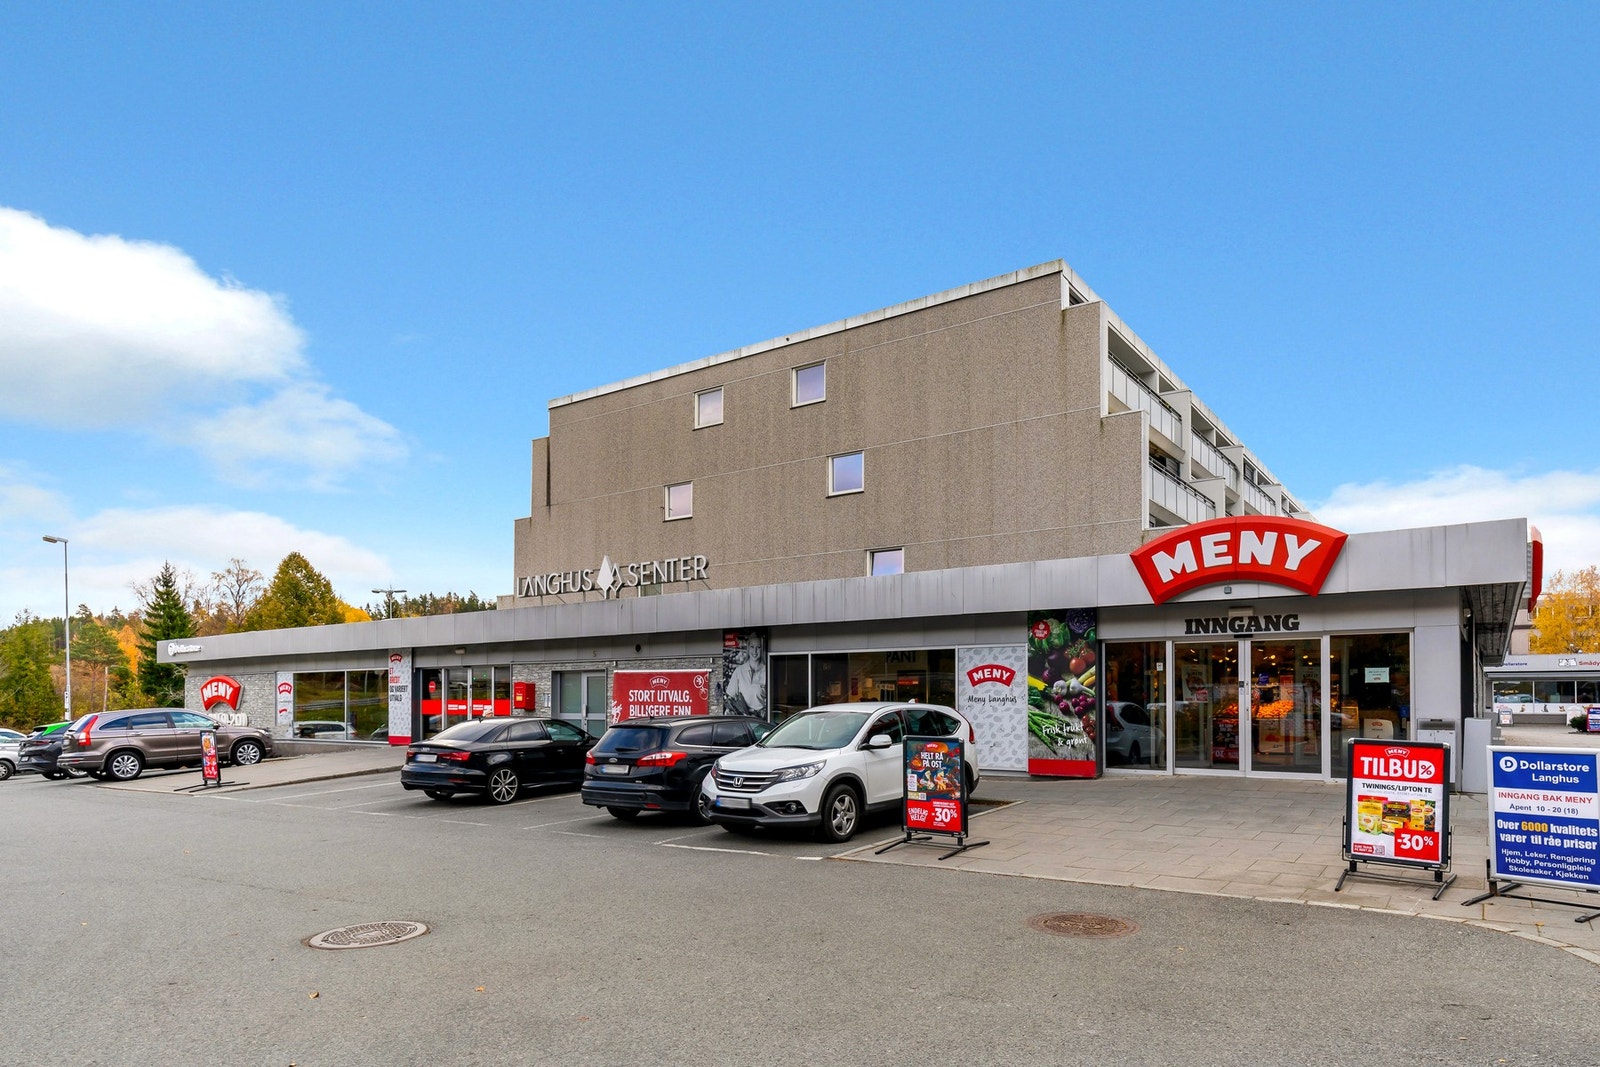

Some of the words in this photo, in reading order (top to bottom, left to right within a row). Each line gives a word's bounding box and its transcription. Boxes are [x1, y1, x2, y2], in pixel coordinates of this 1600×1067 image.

[1151, 530, 1322, 583] MENY
[516, 569, 593, 598] LANGHUS
[627, 555, 709, 587] SENTER
[1185, 614, 1300, 634] INNGANG
[972, 668, 1011, 681] MENY
[202, 681, 233, 701] MENY
[629, 689, 655, 702] STORT
[657, 689, 692, 703] UTVALG.
[968, 695, 986, 706] Meny
[989, 694, 1017, 706] Langhus
[629, 705, 670, 717] BILLIGERE
[673, 705, 691, 715] ENN
[1042, 724, 1060, 735] Frisk
[1063, 723, 1084, 734] frukt
[1057, 739, 1063, 747] &
[1066, 737, 1088, 749] grønt
[920, 752, 934, 760] HELT
[935, 750, 944, 760] RÅ
[1387, 748, 1407, 756] MENY
[922, 759, 931, 767] PÅ
[1520, 760, 1590, 772] Dollarstore
[1532, 773, 1580, 785] Langhus
[1362, 783, 1424, 793] TWININGS/LIPTON
[1498, 791, 1540, 800] INNGANG
[1543, 794, 1562, 803] BAK
[1565, 796, 1593, 804] MENY
[908, 807, 928, 817] ENDELIG
[931, 808, 957, 822] -30%
[1563, 807, 1579, 815] (18)
[1497, 819, 1520, 830] Over
[1521, 821, 1548, 832] 6000
[1550, 823, 1598, 837] kvalitets
[1397, 833, 1434, 851] -30%
[1500, 832, 1527, 843] varer
[1530, 834, 1541, 845] til
[1544, 836, 1562, 846] råe
[1563, 838, 1598, 850] priser
[1501, 848, 1523, 858] Hjem,
[1525, 850, 1549, 859] Leker,
[1550, 853, 1596, 865] Rengjøring
[1505, 856, 1532, 867] Hobby,
[1534, 860, 1592, 872] Personligpleie
[1508, 864, 1554, 876] Skolesaker,
[1555, 870, 1589, 880] Kjøkken
